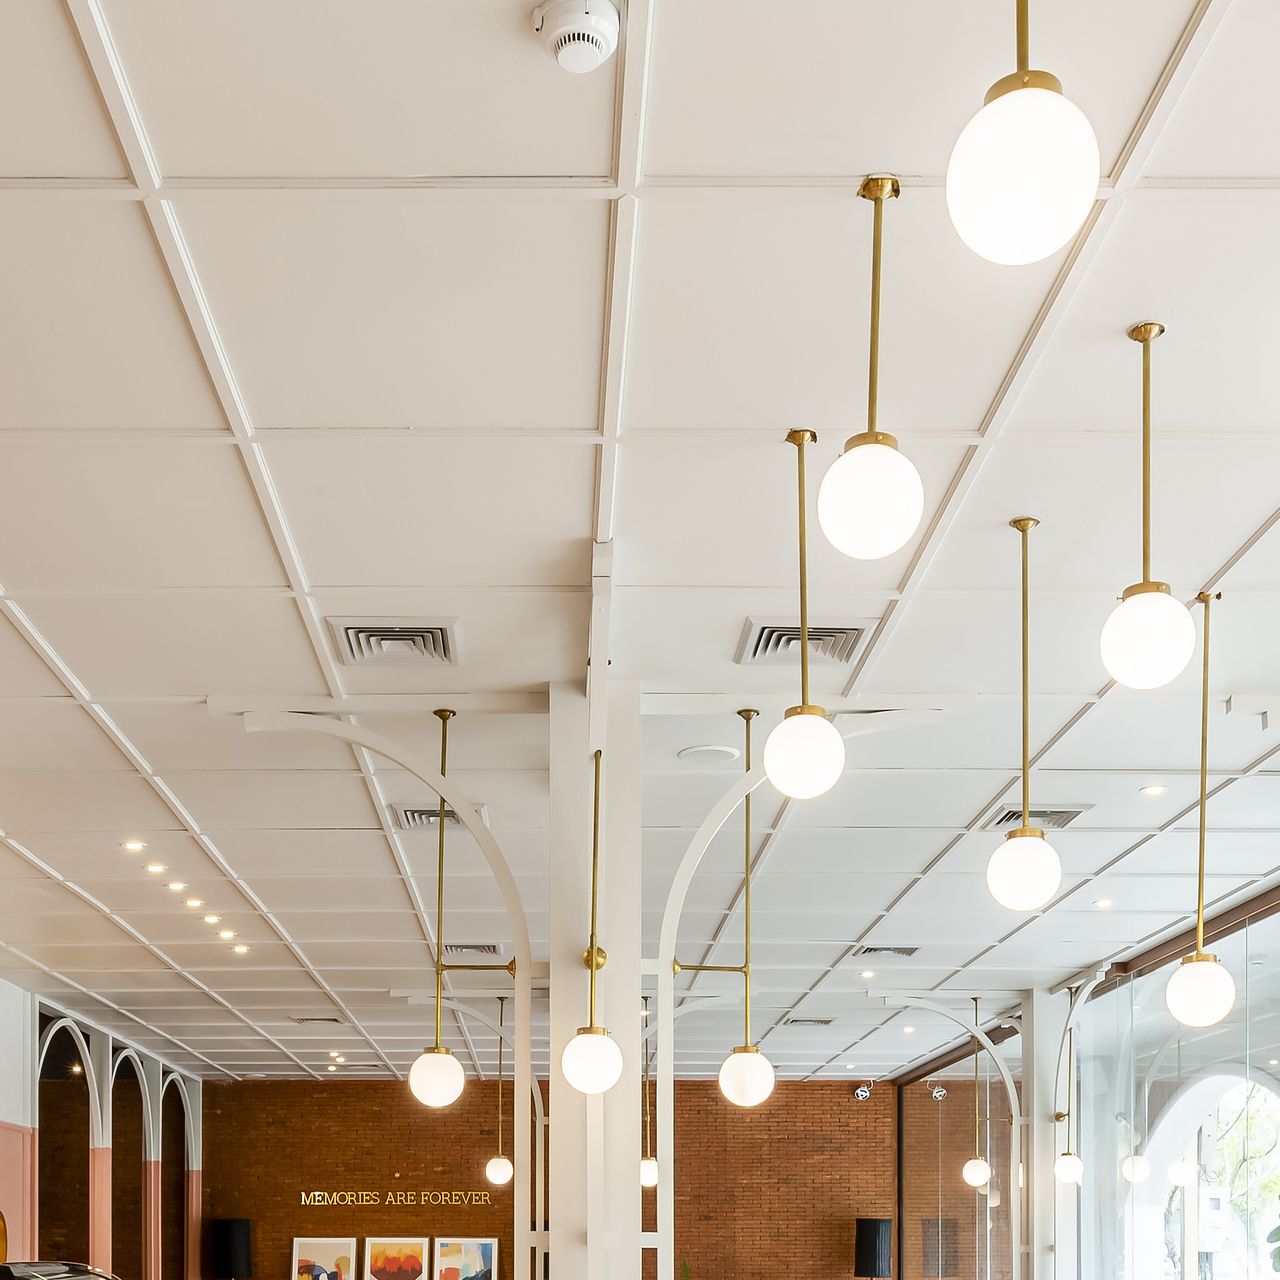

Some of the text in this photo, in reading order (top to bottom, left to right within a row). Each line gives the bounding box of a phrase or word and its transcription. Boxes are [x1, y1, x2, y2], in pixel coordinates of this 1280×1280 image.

[300, 1191, 492, 1206] MEMORIES ARE FOREVER
